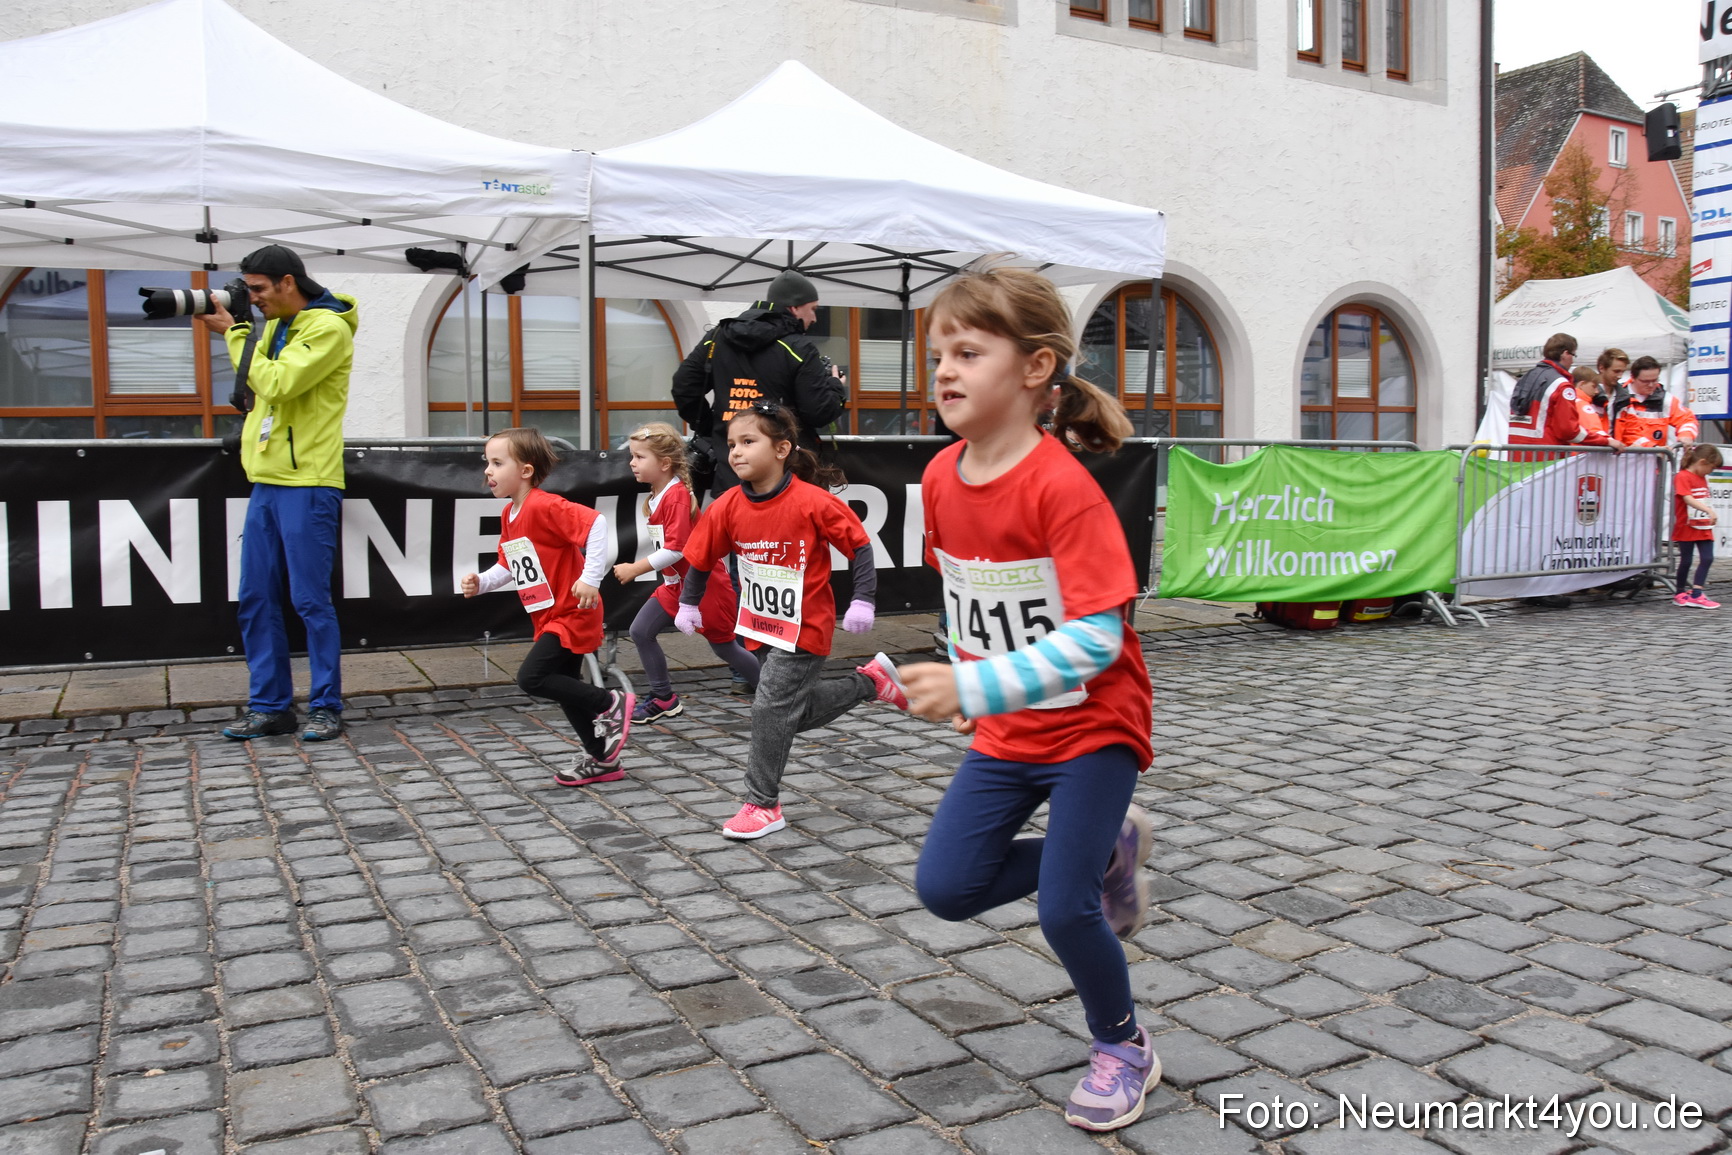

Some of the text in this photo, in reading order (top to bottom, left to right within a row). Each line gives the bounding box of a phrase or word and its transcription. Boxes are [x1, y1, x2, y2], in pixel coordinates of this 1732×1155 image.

[729, 388, 764, 399] FOTO-
[1211, 484, 1335, 525] Herzlich
[511, 556, 538, 586] 28
[757, 566, 799, 581] BOCK
[1206, 539, 1397, 578] Willkommen
[967, 565, 1044, 586] BOCK
[744, 576, 796, 618] 7099
[751, 617, 784, 636] Victoria
[949, 588, 1056, 652] 7415
